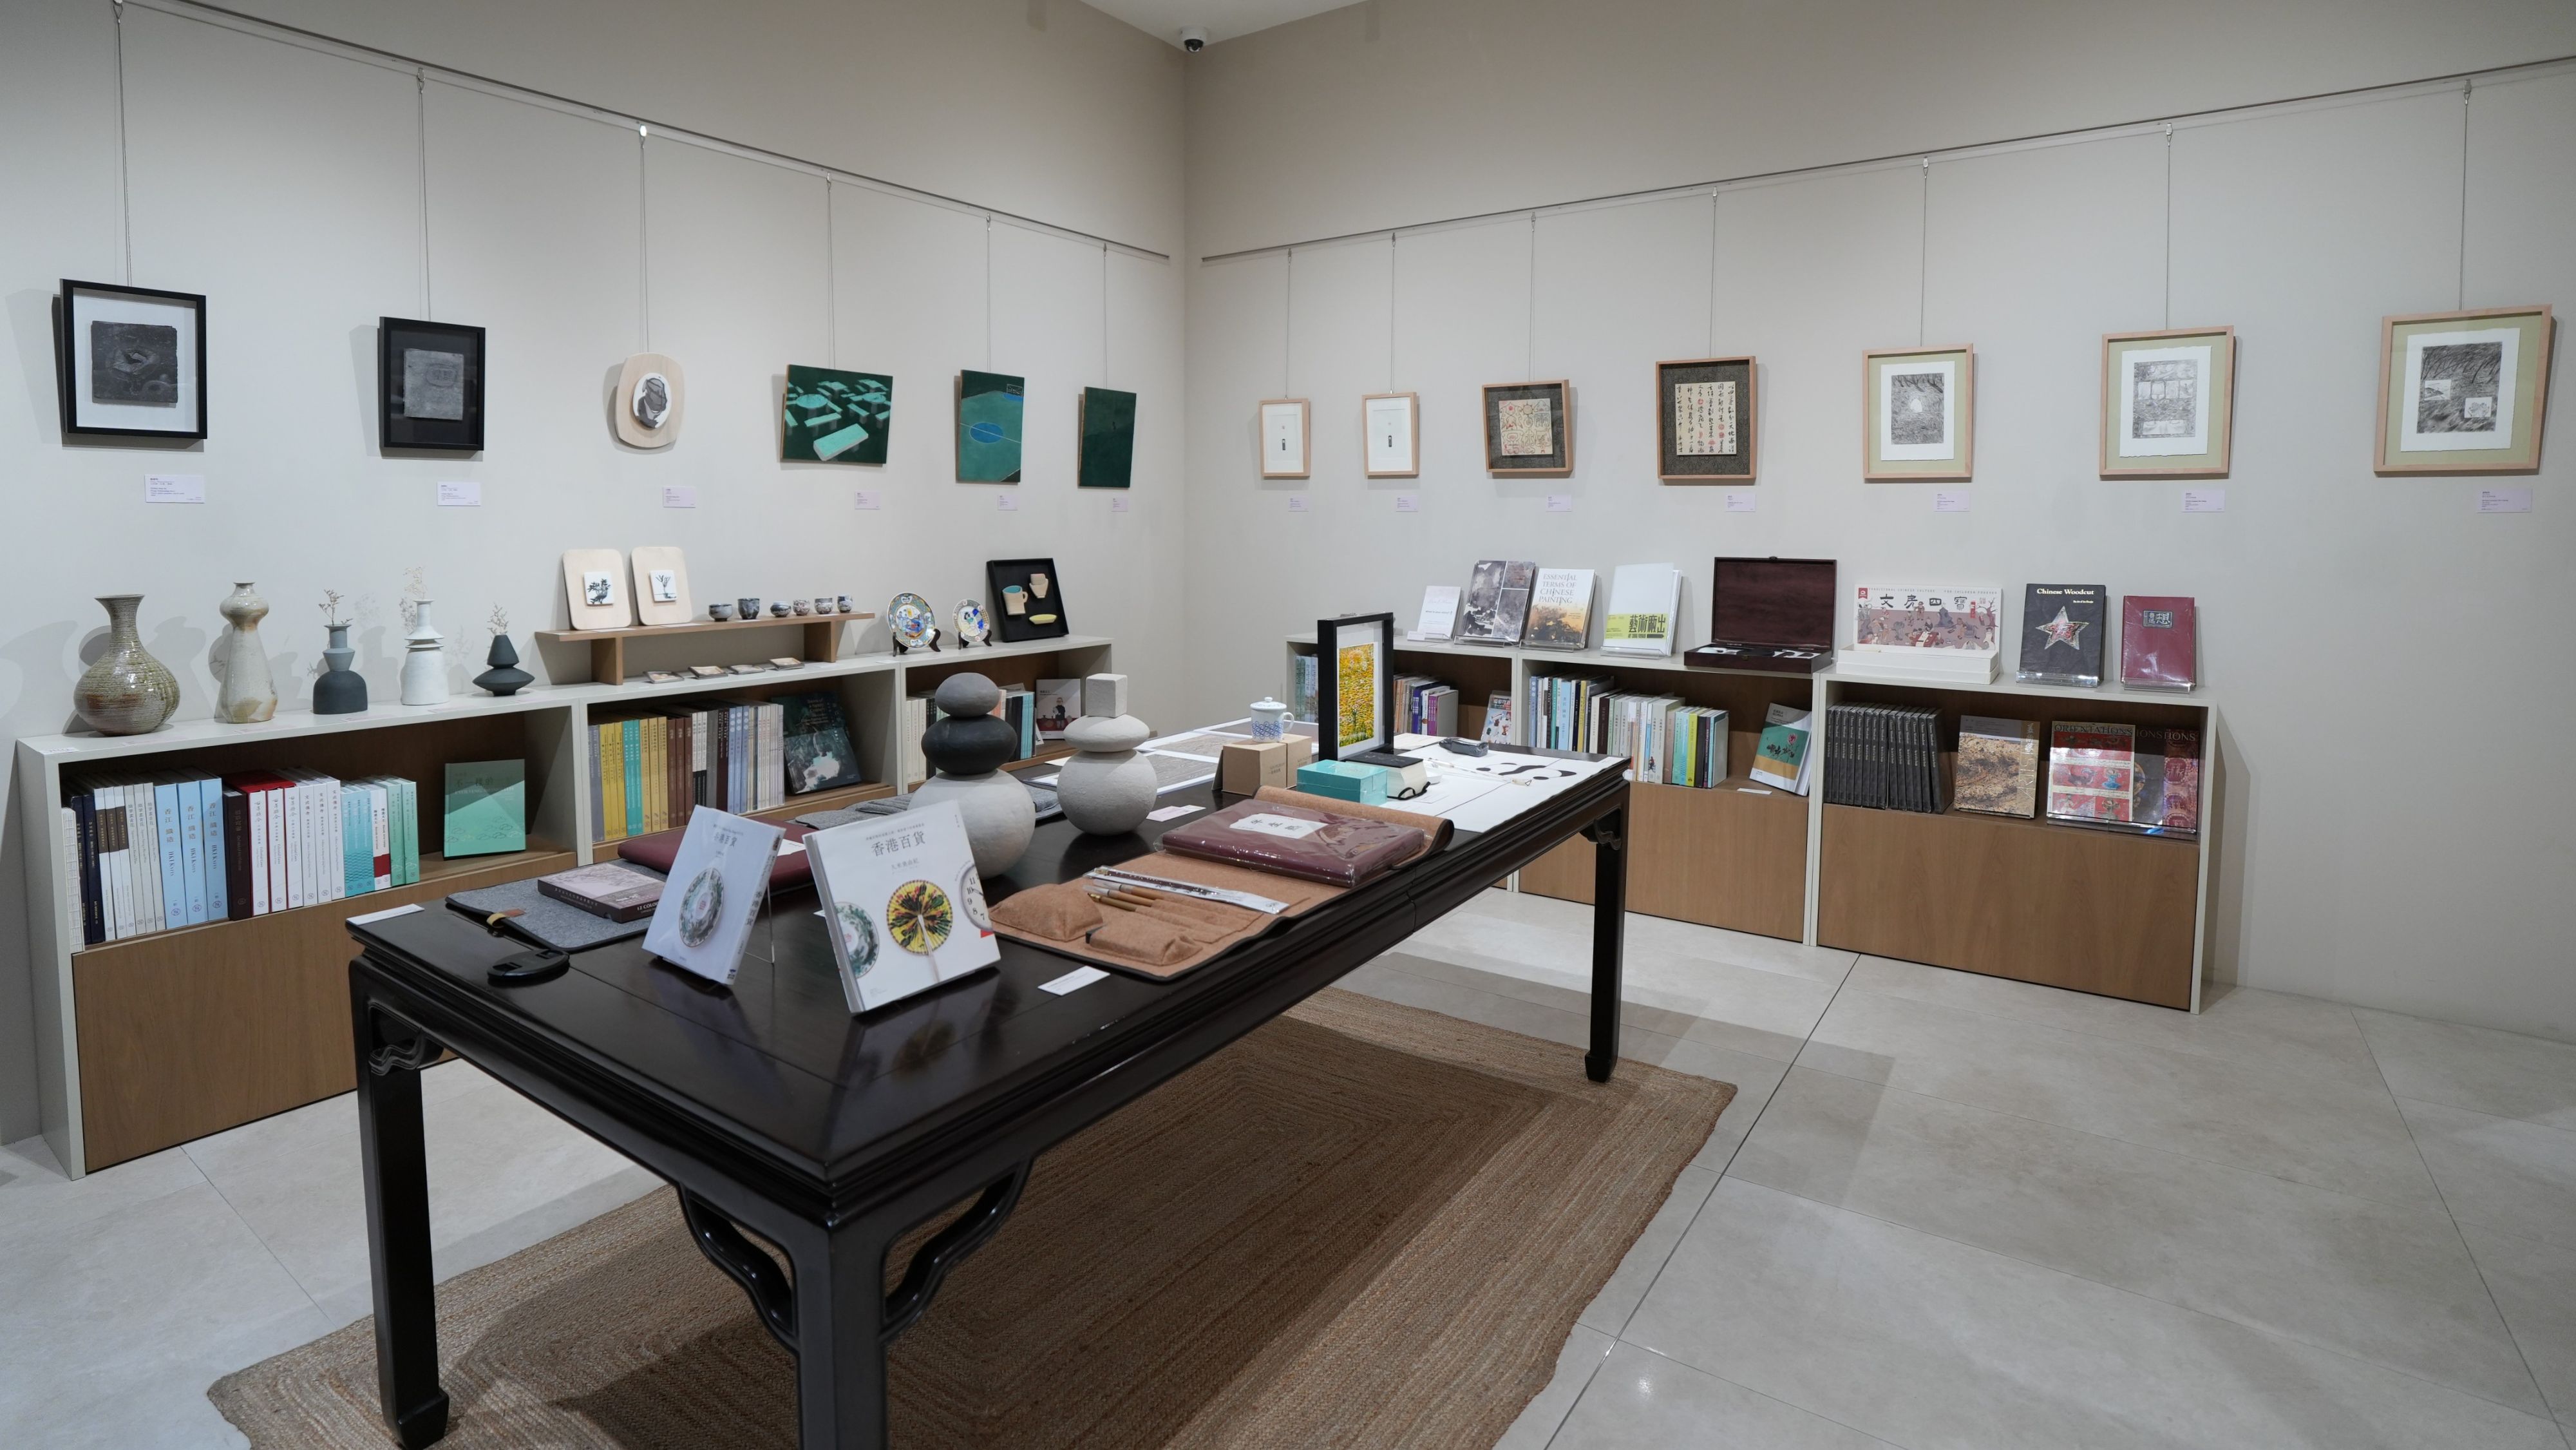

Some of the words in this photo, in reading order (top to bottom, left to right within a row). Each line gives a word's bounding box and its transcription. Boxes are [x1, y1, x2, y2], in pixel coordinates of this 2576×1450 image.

[1543, 573, 1577, 581] ESSENTIAL
[1540, 588, 1574, 596] CHINESE
[1539, 596, 1573, 606] PAINTING
[1629, 614, 1666, 633] 藝術廠出
[2054, 724, 2134, 736] ORIENTATIONS
[871, 830, 925, 857] 香港百貨
[969, 877, 976, 885] 11
